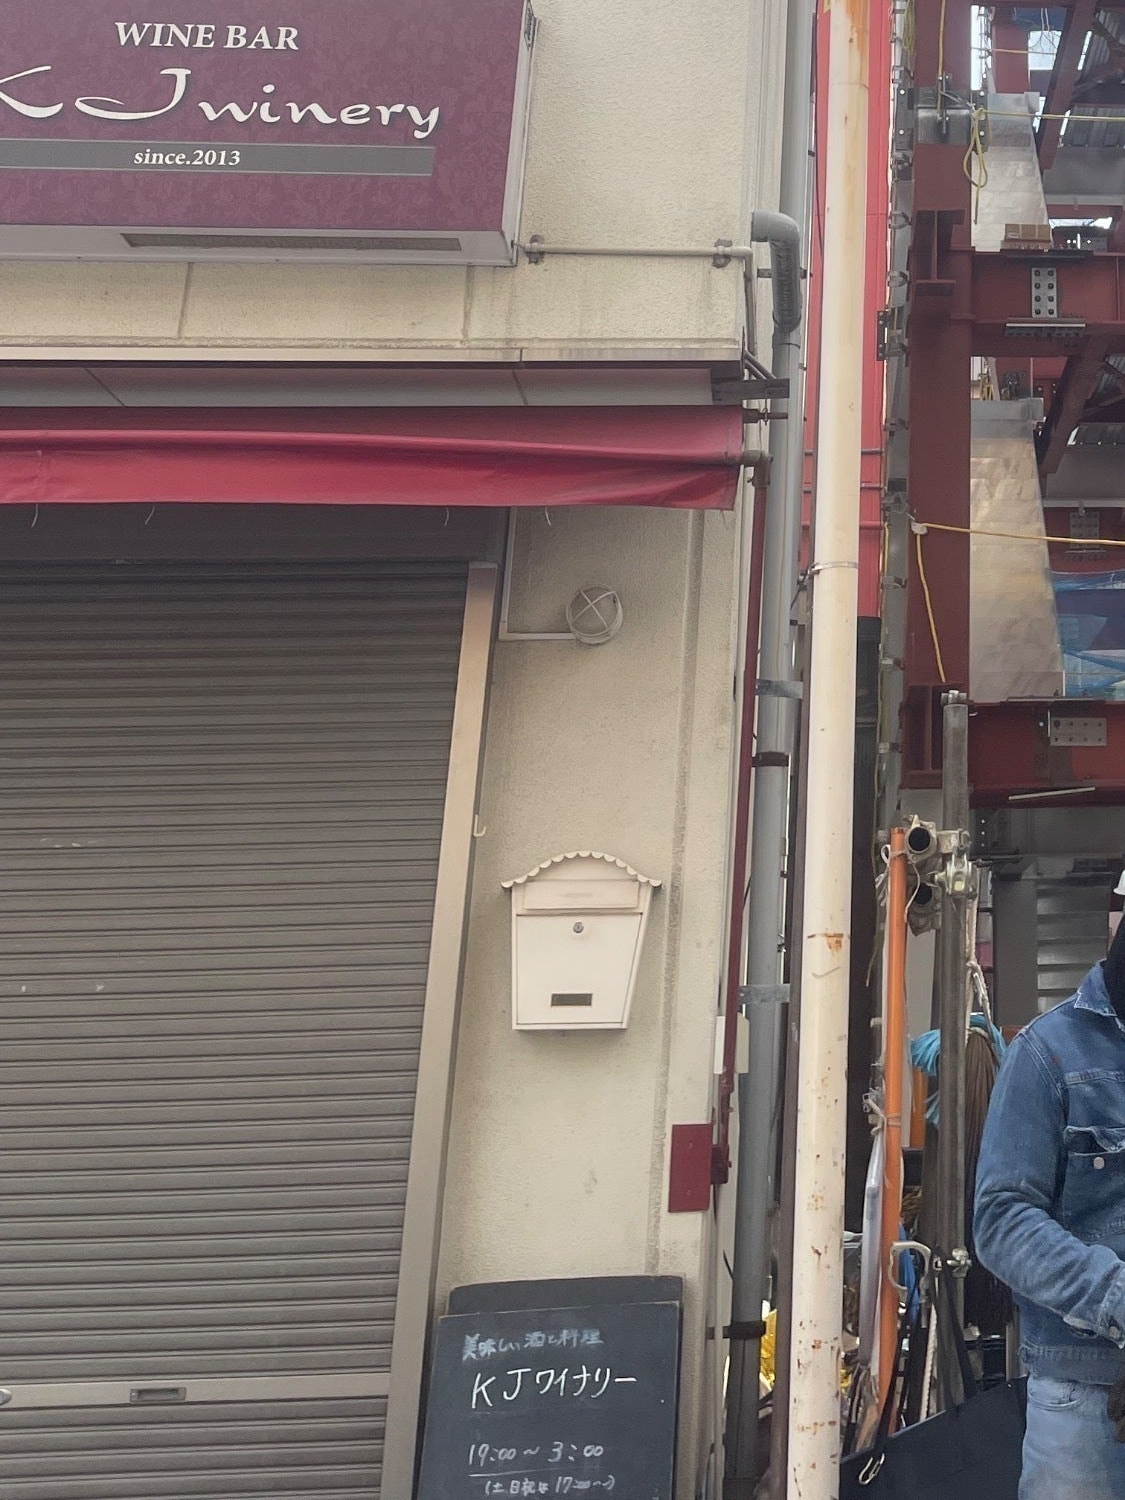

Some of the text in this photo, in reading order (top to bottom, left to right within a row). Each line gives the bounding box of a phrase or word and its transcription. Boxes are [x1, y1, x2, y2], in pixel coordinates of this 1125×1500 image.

[114, 21, 300, 51] WINE BAR
[133, 146, 241, 167] since.2013
